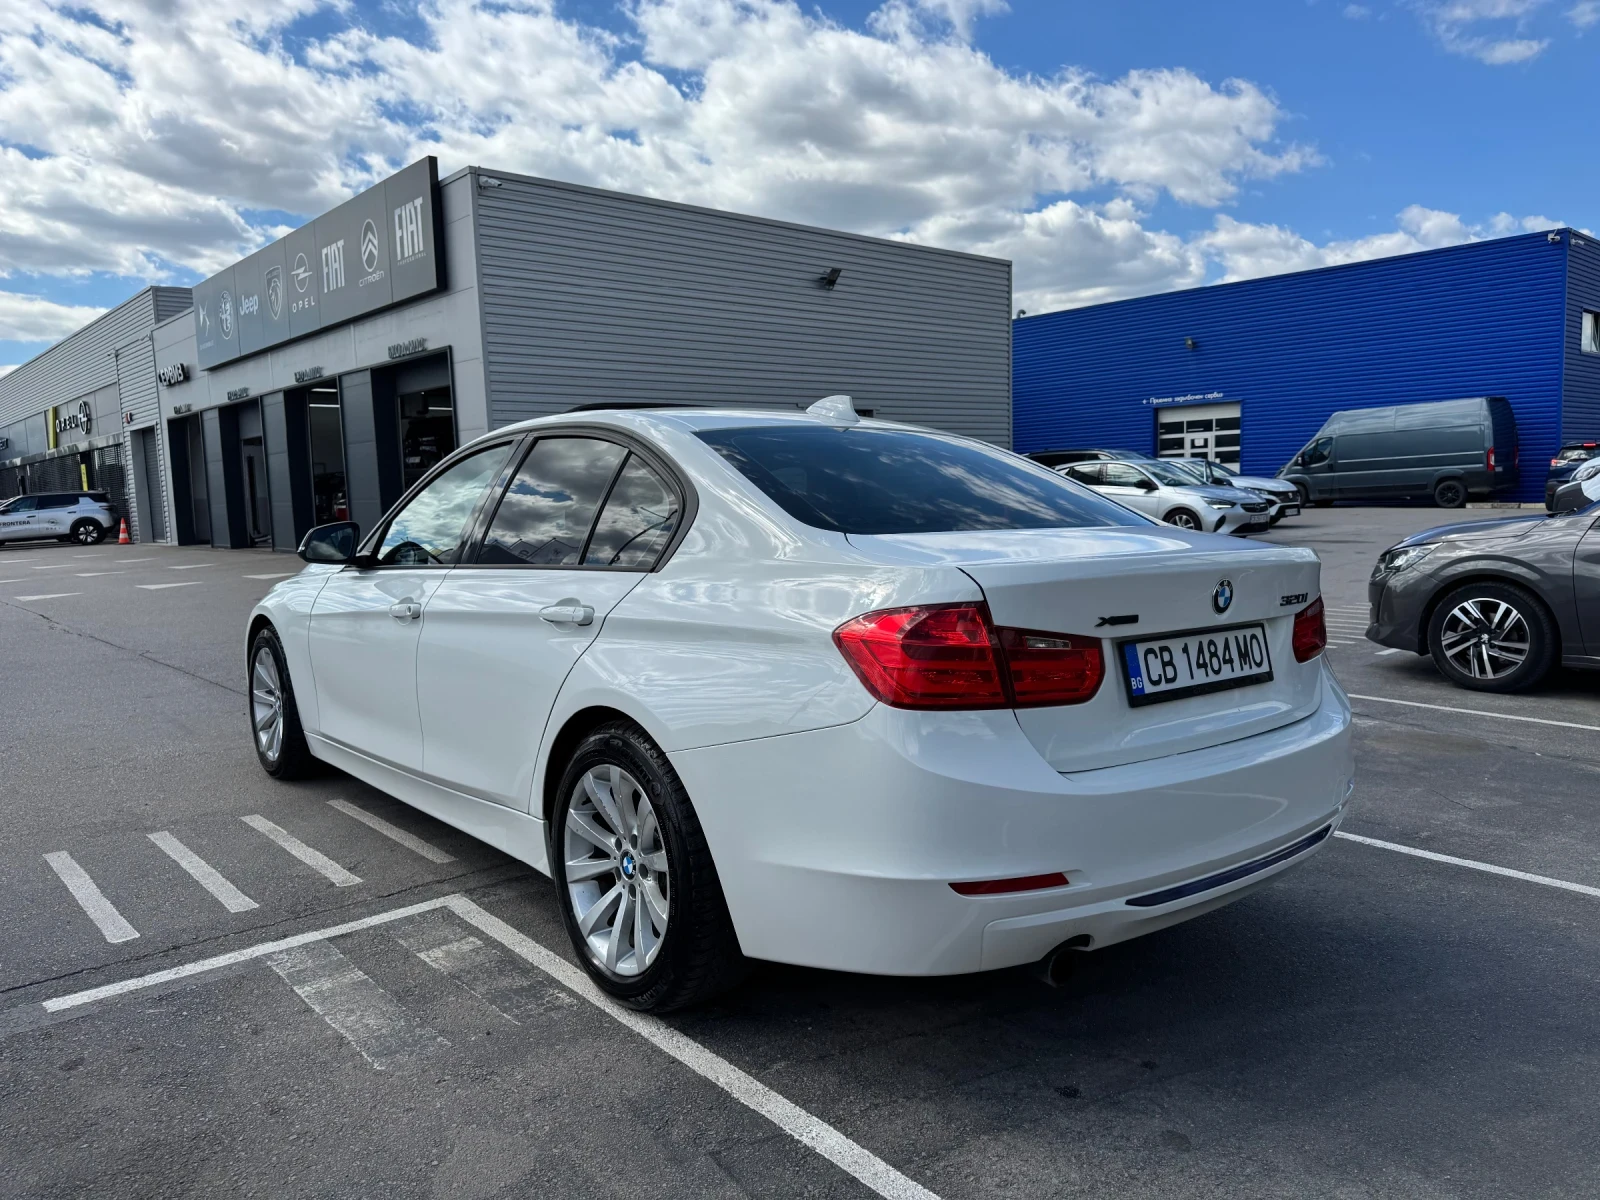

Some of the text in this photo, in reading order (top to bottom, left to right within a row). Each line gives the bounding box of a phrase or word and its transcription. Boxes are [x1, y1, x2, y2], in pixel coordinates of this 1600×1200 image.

[394, 196, 424, 261] FIAT
[321, 239, 345, 293] FIAT
[239, 293, 259, 316] Jeep
[292, 295, 315, 313] OPEL
[1144, 632, 1264, 687] CB 1484 MO
[1131, 677, 1143, 690] BG
